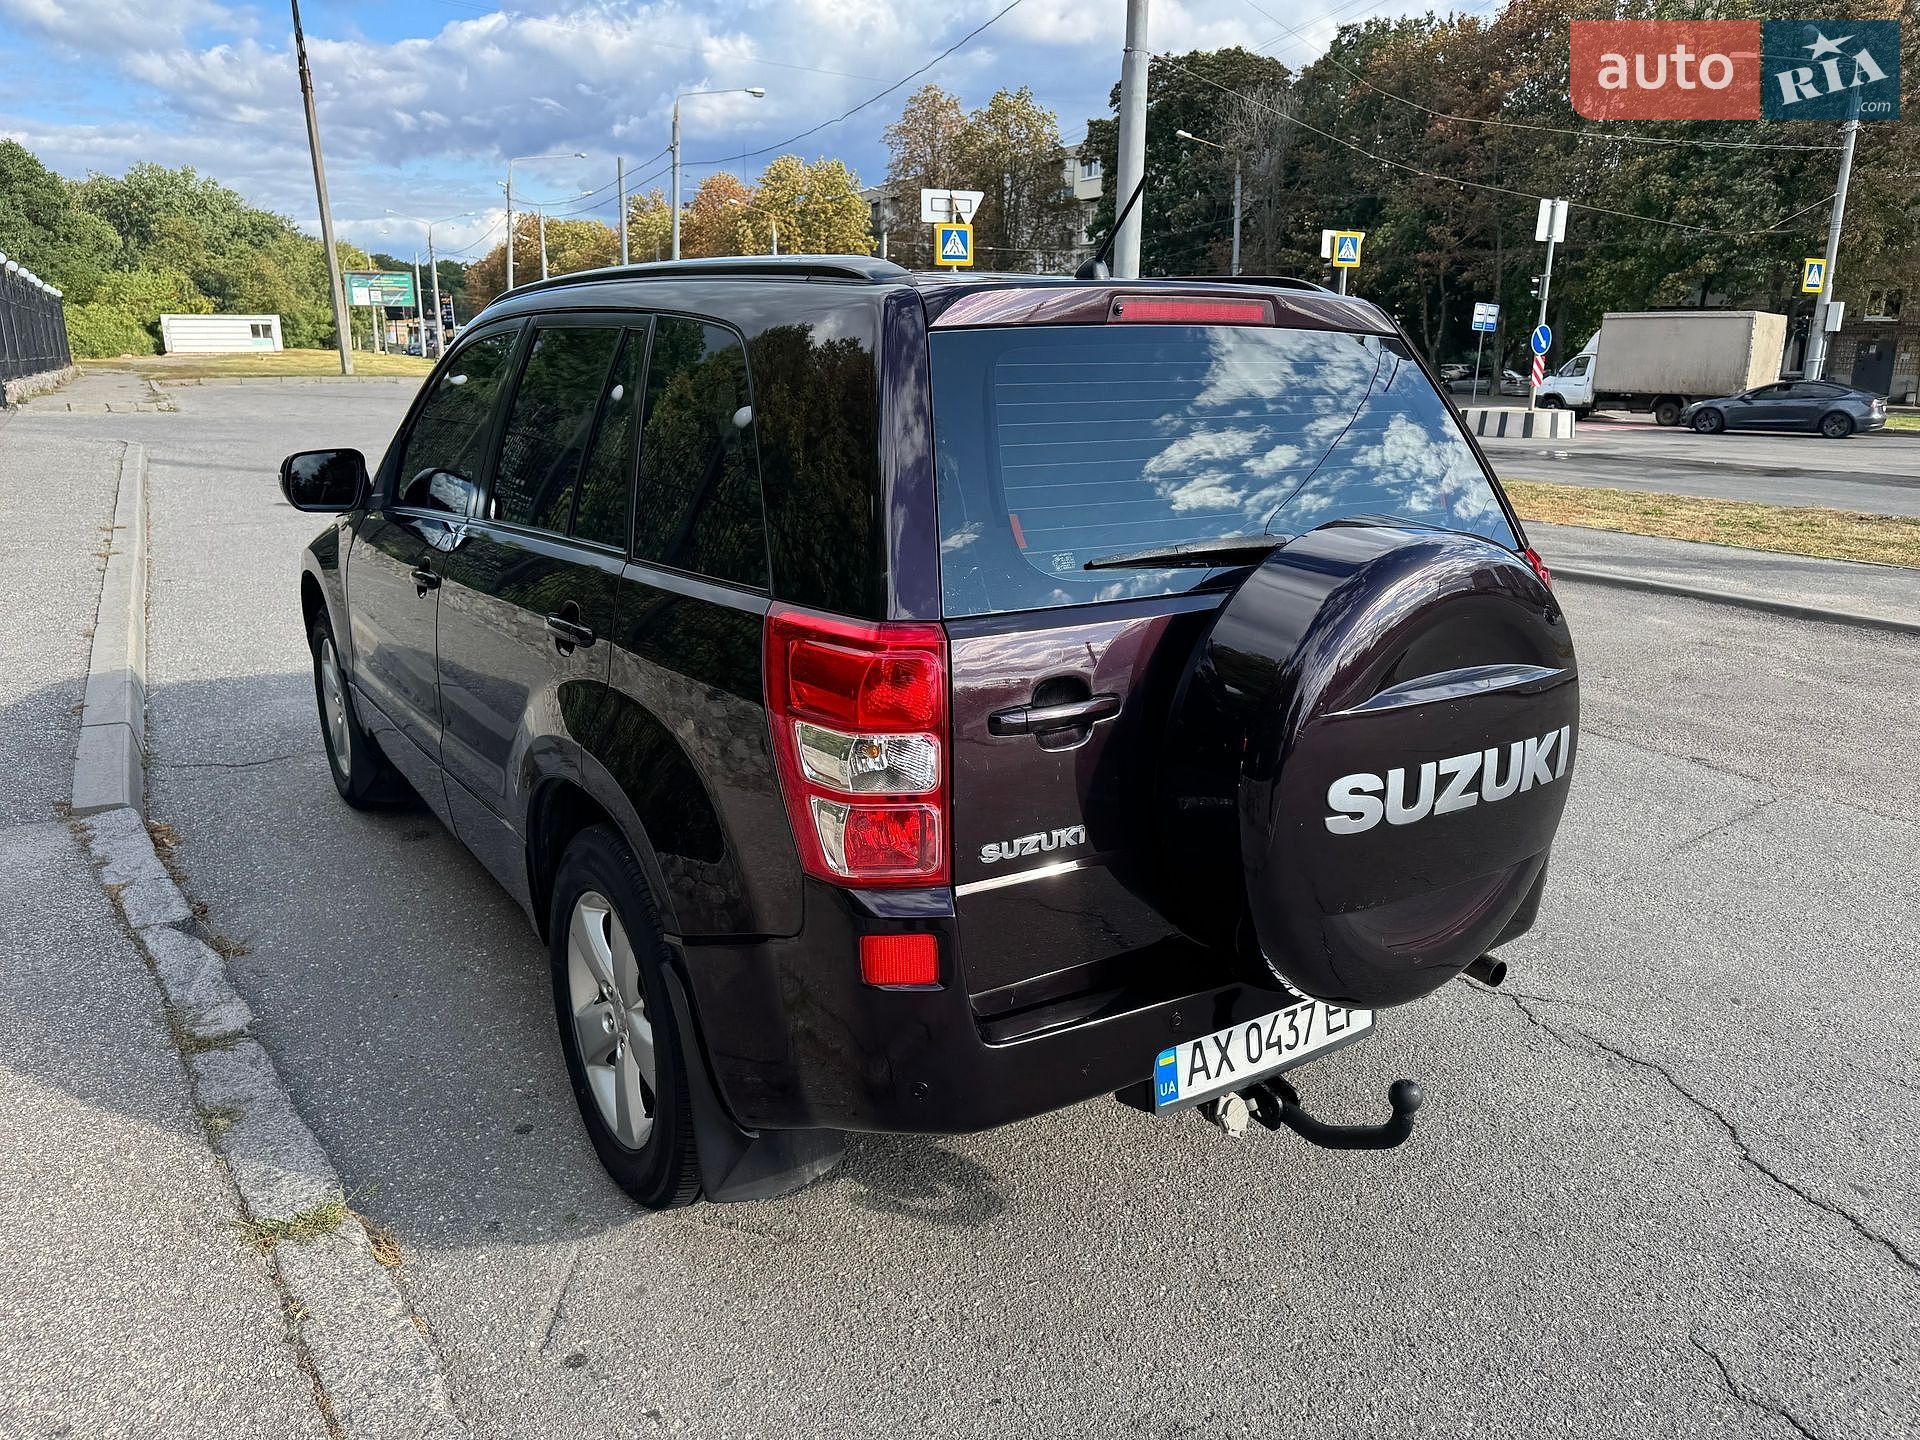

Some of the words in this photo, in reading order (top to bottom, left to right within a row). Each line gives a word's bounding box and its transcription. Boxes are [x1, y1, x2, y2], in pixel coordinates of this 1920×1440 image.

[1324, 725, 1570, 835] SUZUKI
[979, 824, 1086, 864] SUZUKI
[1187, 1029, 1236, 1087] AX
[1245, 1001, 1317, 1064] 0437
[1159, 1082, 1177, 1097] UA
